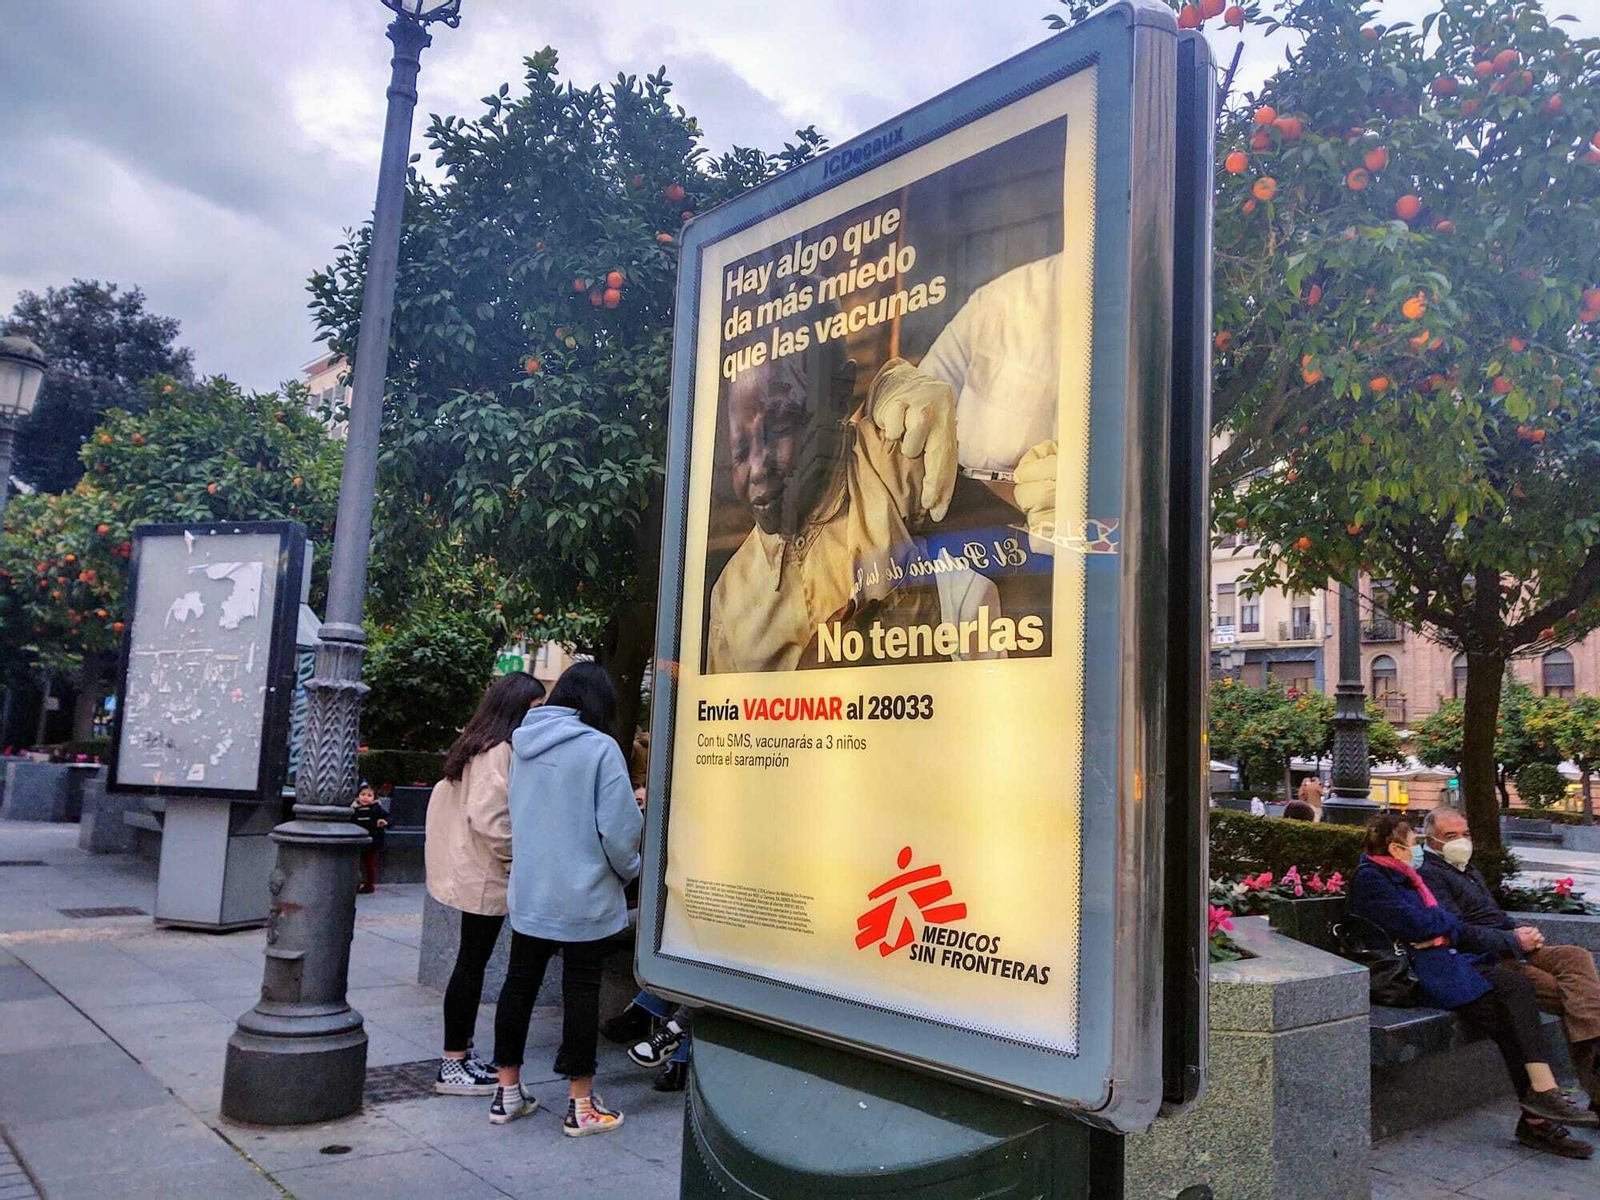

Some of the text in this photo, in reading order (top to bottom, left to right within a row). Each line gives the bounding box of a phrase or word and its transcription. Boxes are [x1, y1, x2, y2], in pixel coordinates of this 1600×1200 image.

[726, 207, 900, 301] Hay algo que
[724, 242, 916, 341] da más miedo
[723, 275, 947, 382] que las vacunas
[817, 606, 1044, 663] No tenerlas
[697, 694, 934, 721] Envía VACUNAR al 28033
[696, 752, 789, 770] contra el sarampión
[697, 733, 867, 751] Con tu SMS, vacunarás a 3 niños
[921, 925, 1001, 955] MEDICOS
[909, 943, 1051, 985] SIN FRONTERAS
